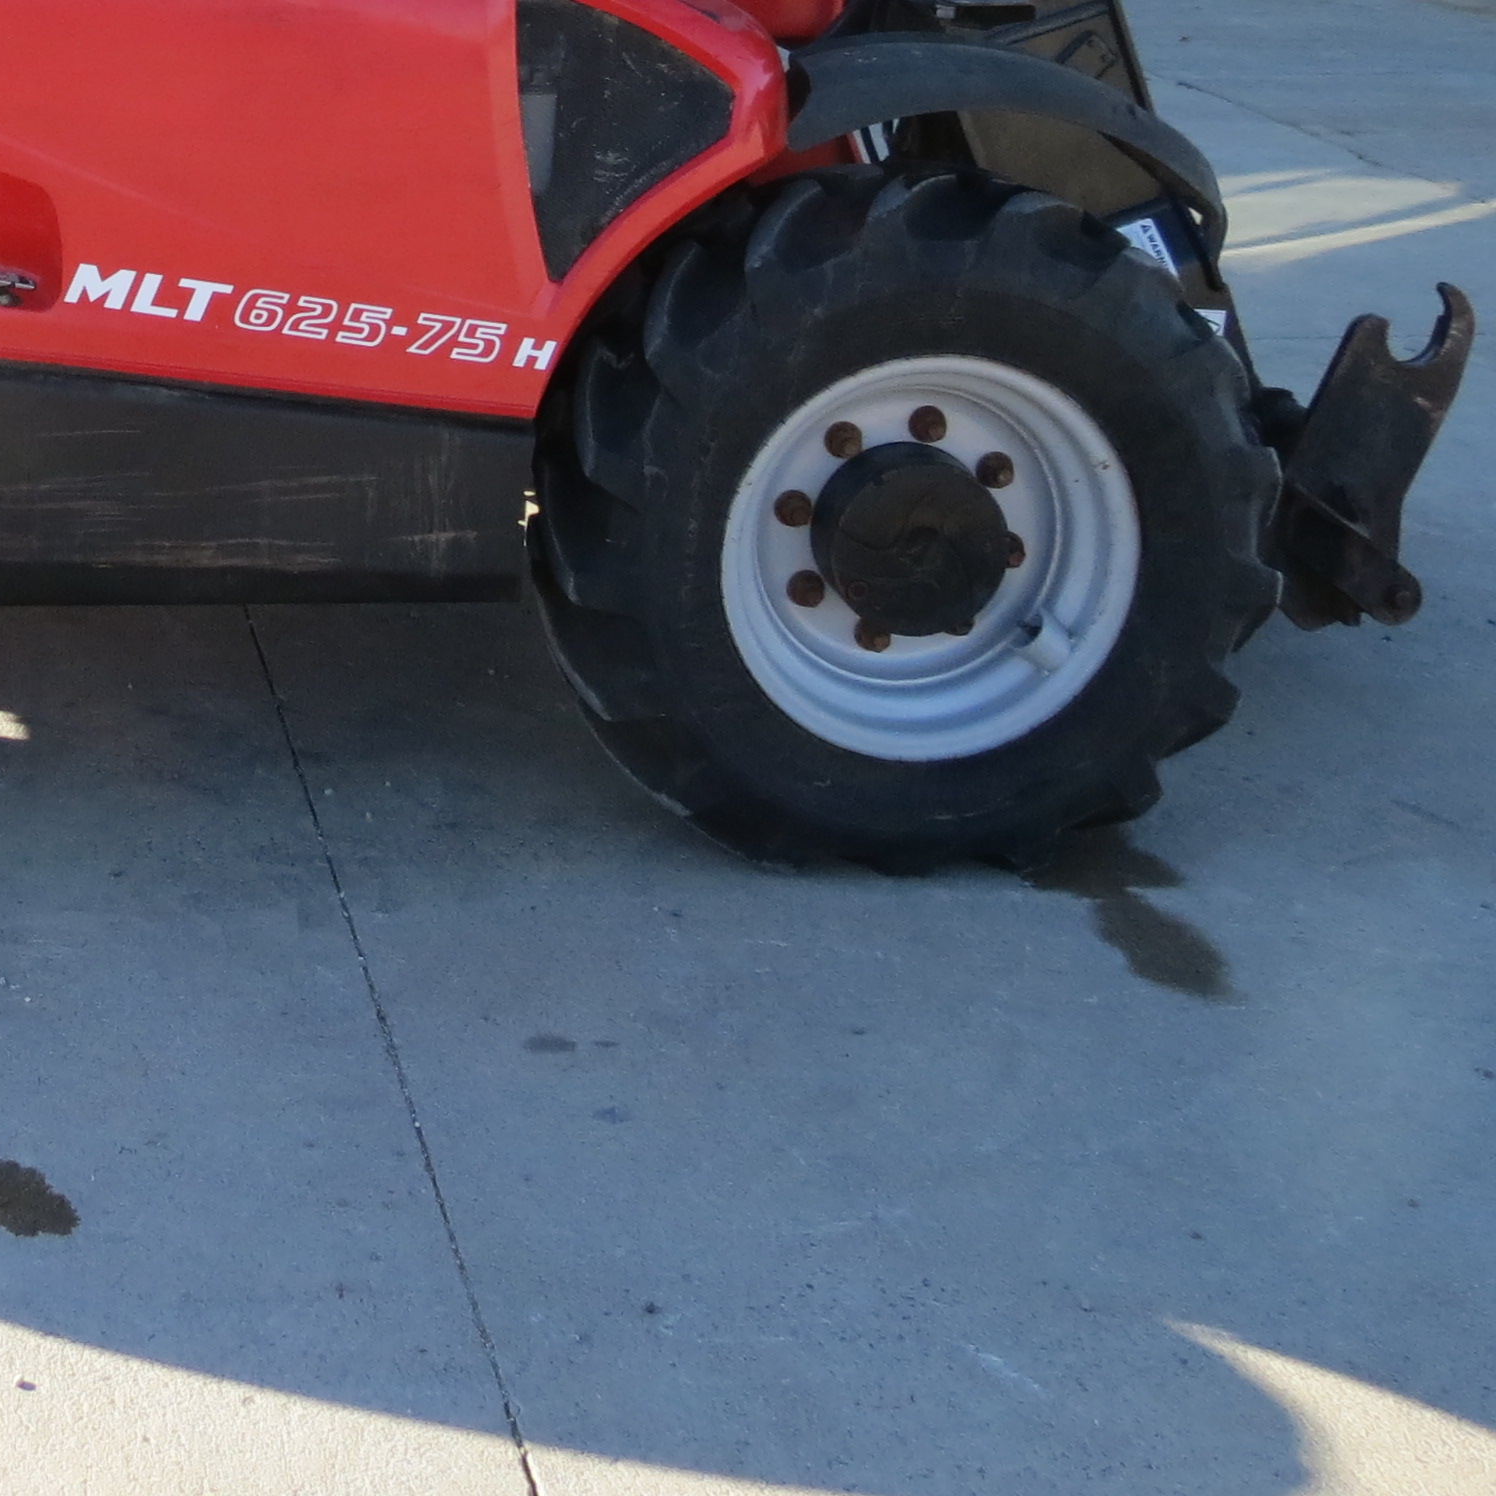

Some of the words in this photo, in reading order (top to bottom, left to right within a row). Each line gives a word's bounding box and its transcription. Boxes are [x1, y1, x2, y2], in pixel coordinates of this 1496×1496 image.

[63, 263, 233, 322] MLT
[233, 289, 507, 363] 625-75
[512, 337, 557, 371] H
